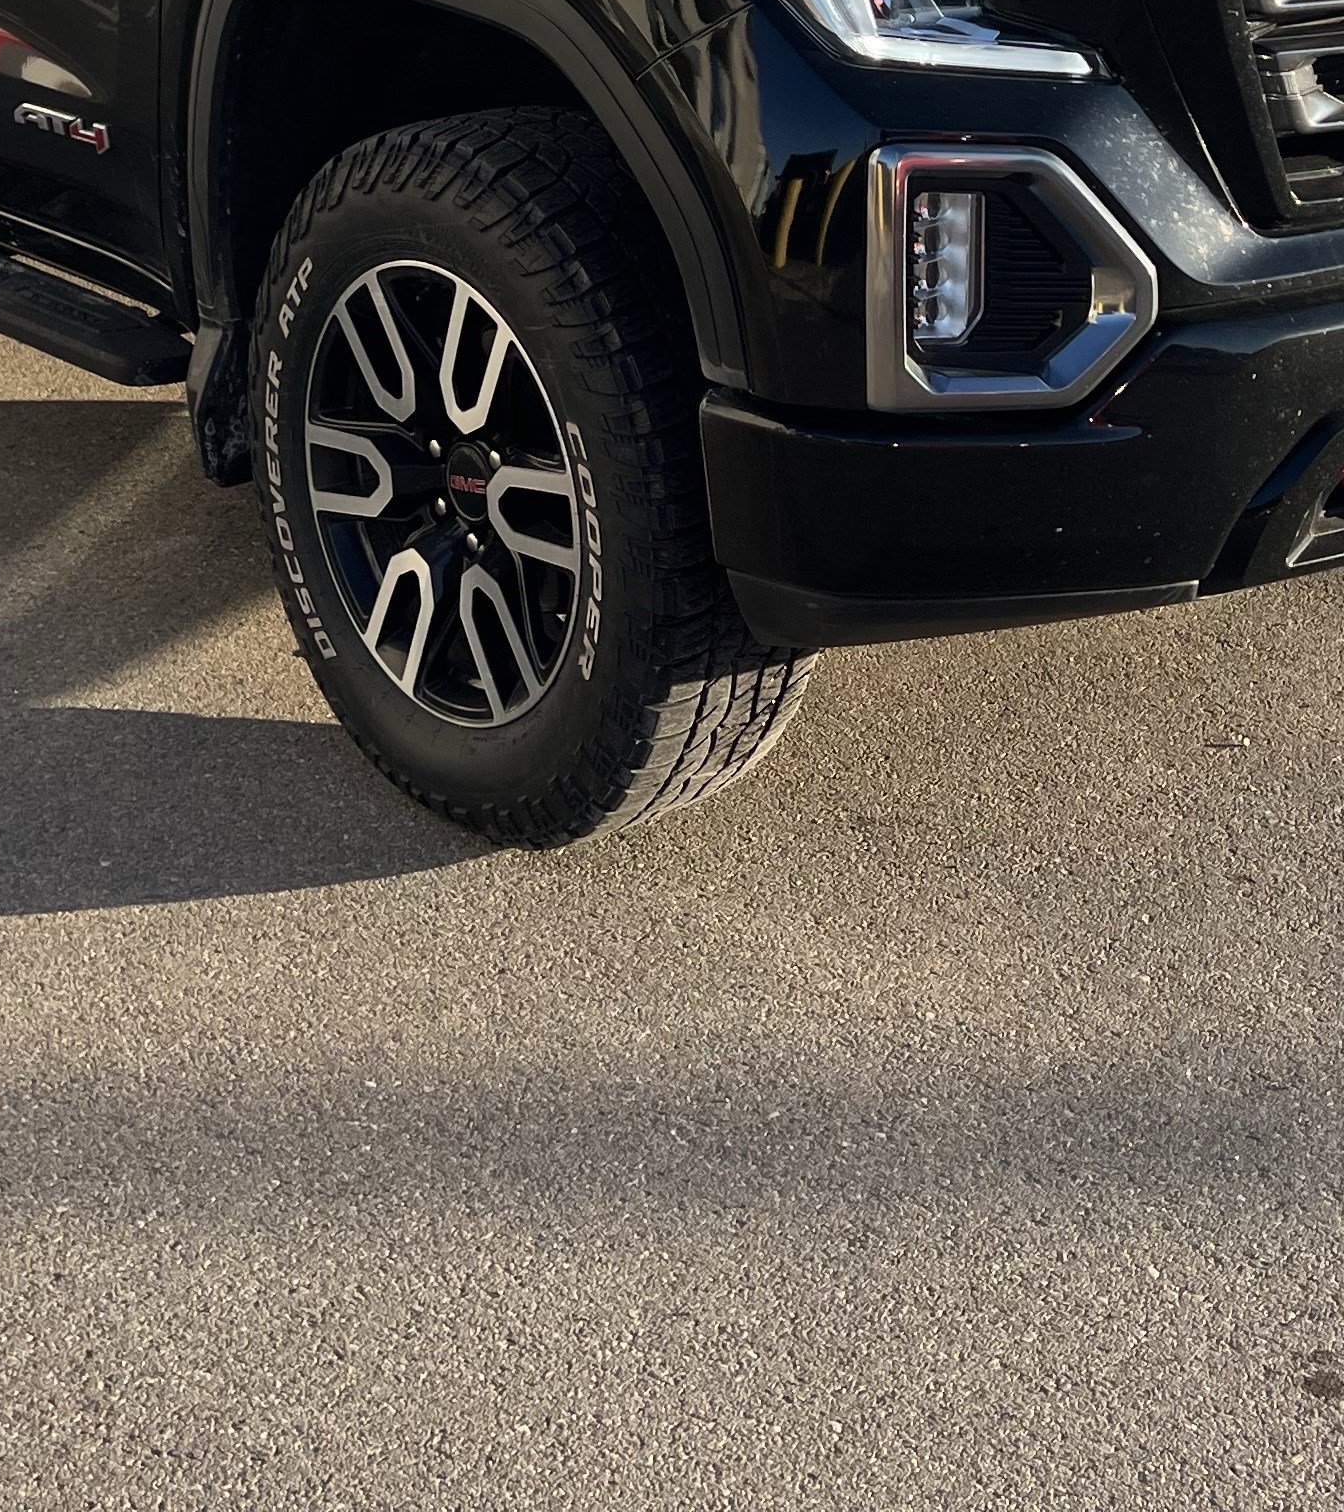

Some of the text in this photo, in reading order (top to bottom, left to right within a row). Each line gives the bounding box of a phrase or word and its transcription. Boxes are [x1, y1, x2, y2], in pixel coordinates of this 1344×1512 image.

[14, 102, 110, 155] AT4
[263, 256, 336, 659] DISCOVERER ATP
[450, 475, 486, 495] GMC
[565, 420, 604, 681] COOPER
